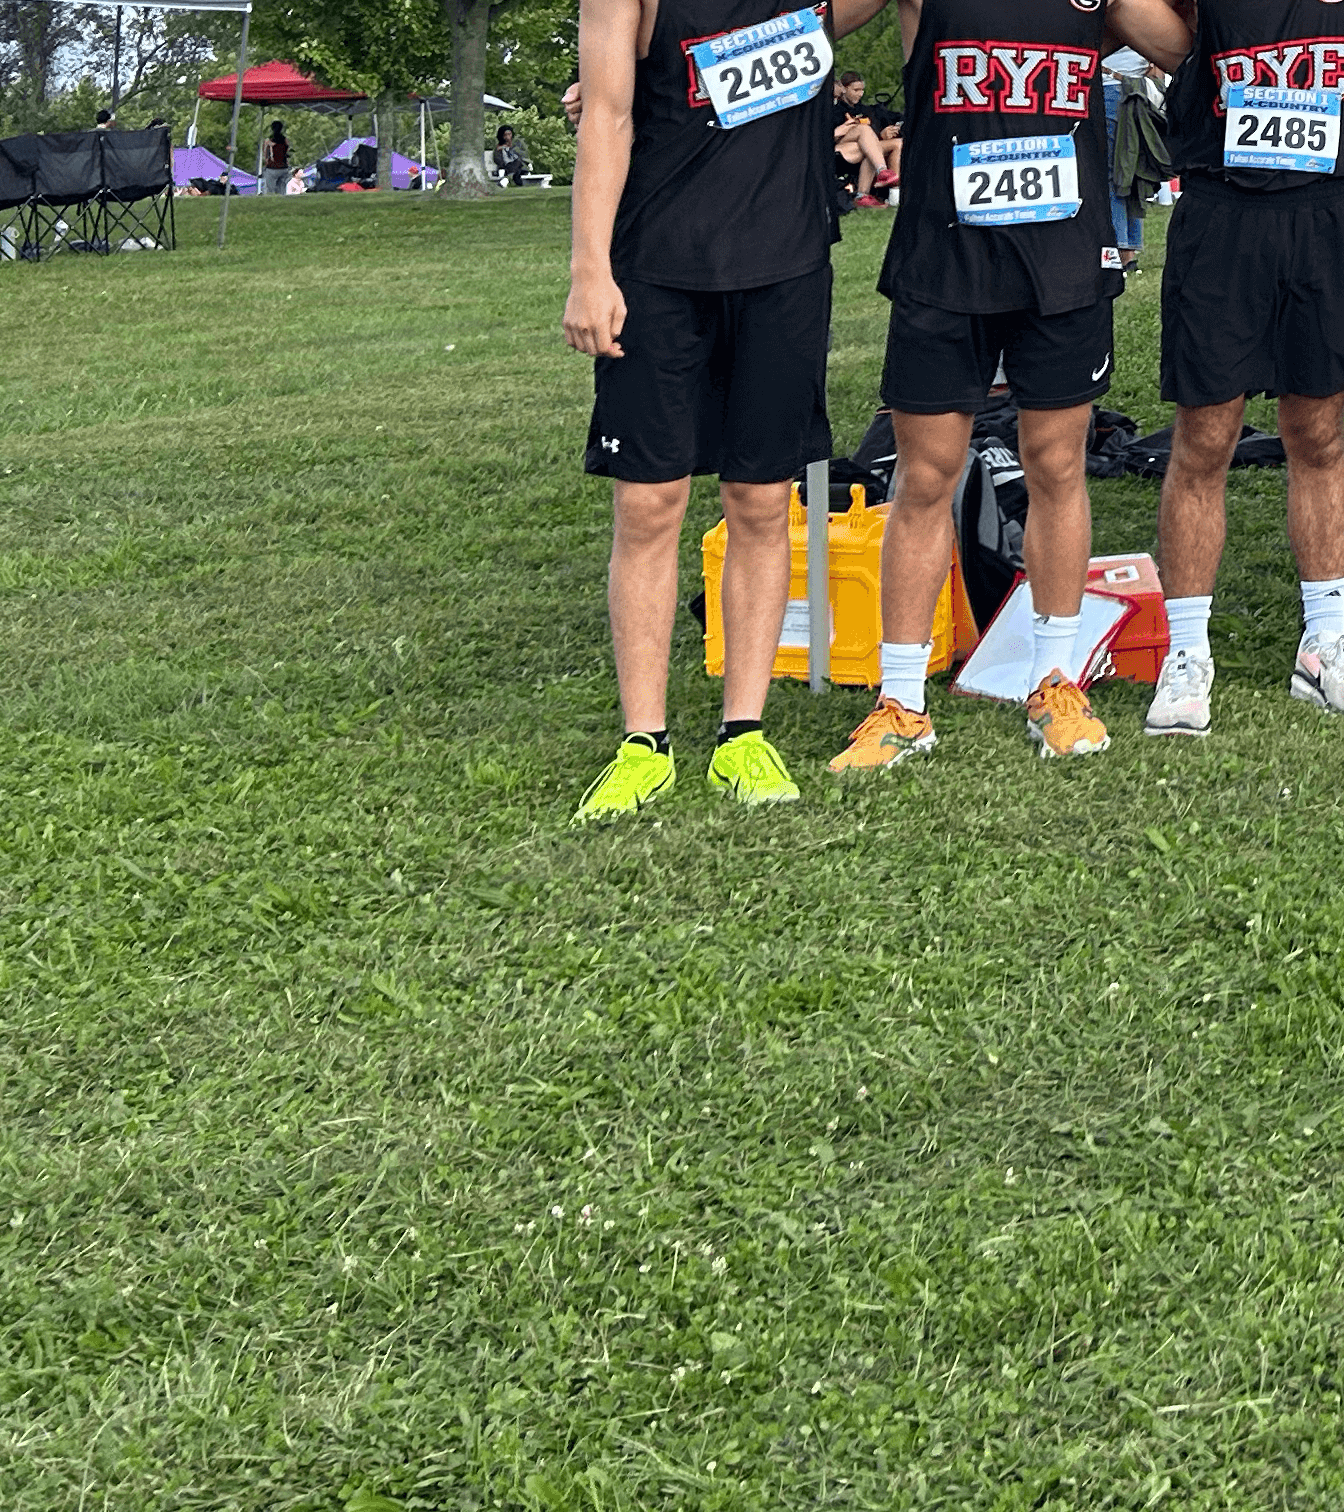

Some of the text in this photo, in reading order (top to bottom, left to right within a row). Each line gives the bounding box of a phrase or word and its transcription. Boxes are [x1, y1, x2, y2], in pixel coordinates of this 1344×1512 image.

[710, 19, 790, 53] SECTION
[716, 26, 806, 62] X-COUNTRY
[719, 42, 820, 104] 2483
[934, 41, 1098, 118] RYE
[1243, 87, 1316, 104] SECTION
[1244, 100, 1328, 113] X-COUNTRY
[969, 139, 1048, 156] SECTION
[1237, 114, 1327, 151] 2485
[971, 150, 1061, 164] X-COUNTRY
[968, 164, 1061, 205] 2481
